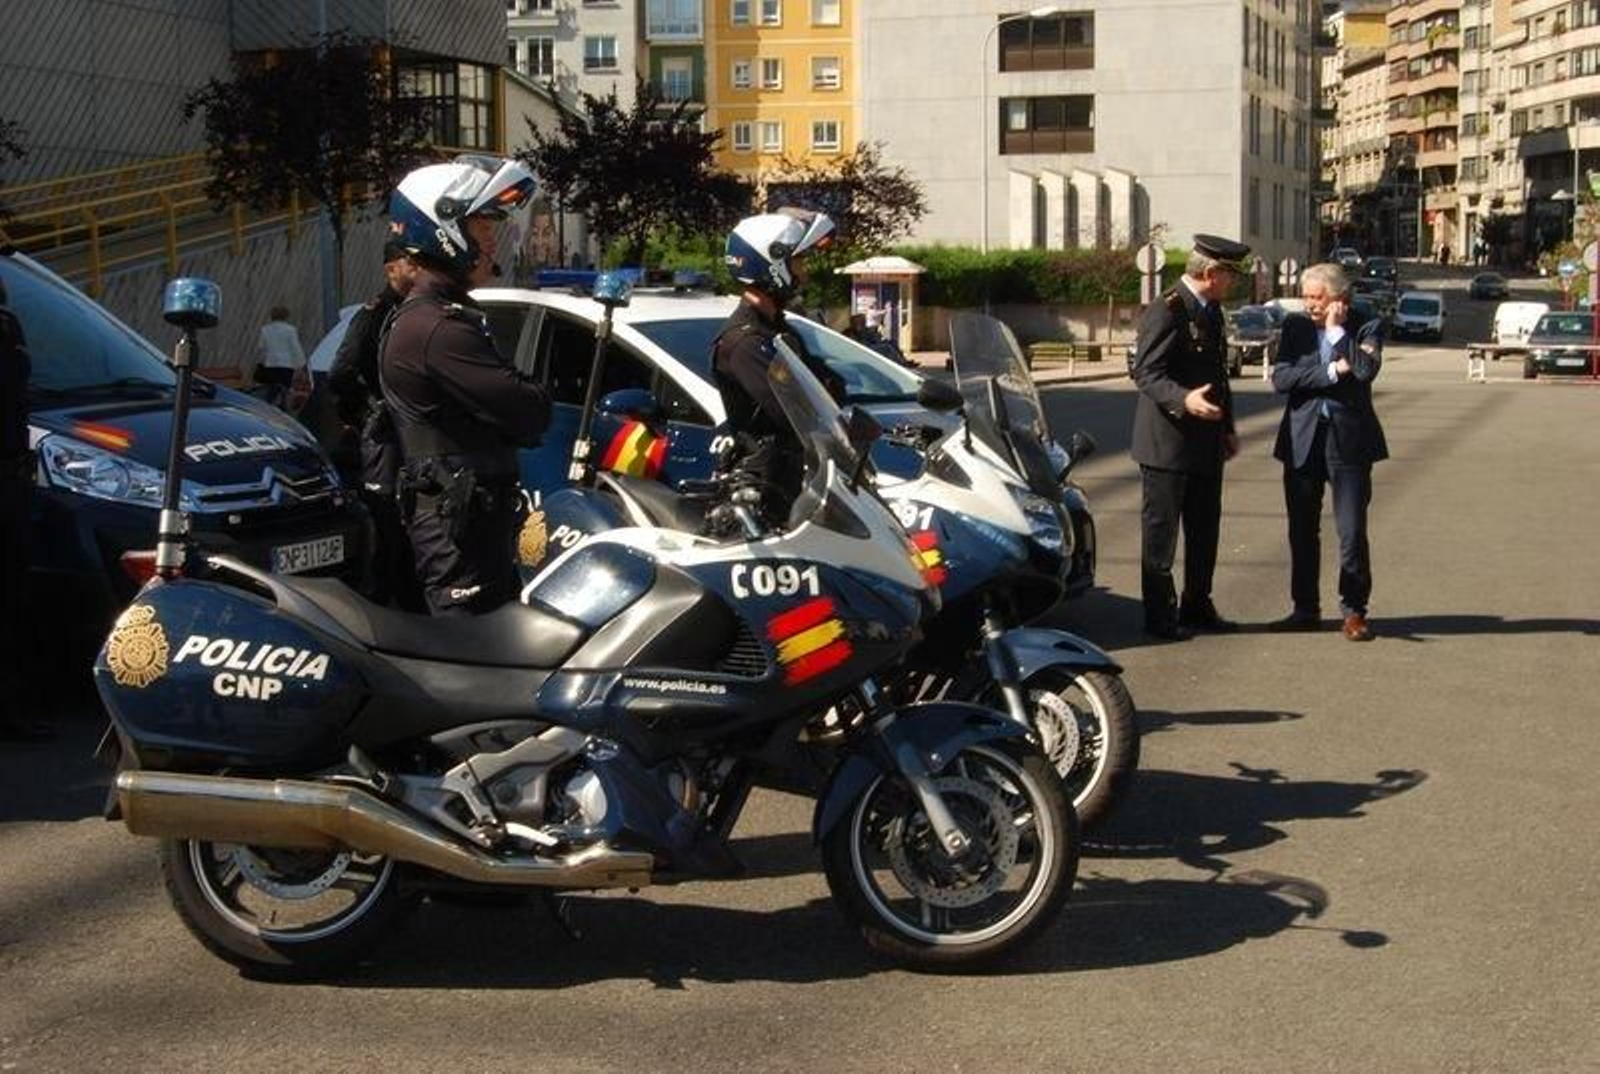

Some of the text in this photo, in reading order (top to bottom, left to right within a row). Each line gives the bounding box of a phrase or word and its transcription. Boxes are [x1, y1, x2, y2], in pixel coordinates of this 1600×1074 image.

[184, 436, 298, 462] POLICIA
[173, 635, 330, 680] POLICIA
[213, 672, 283, 700] CNP
[623, 678, 726, 694] www.policia.es
